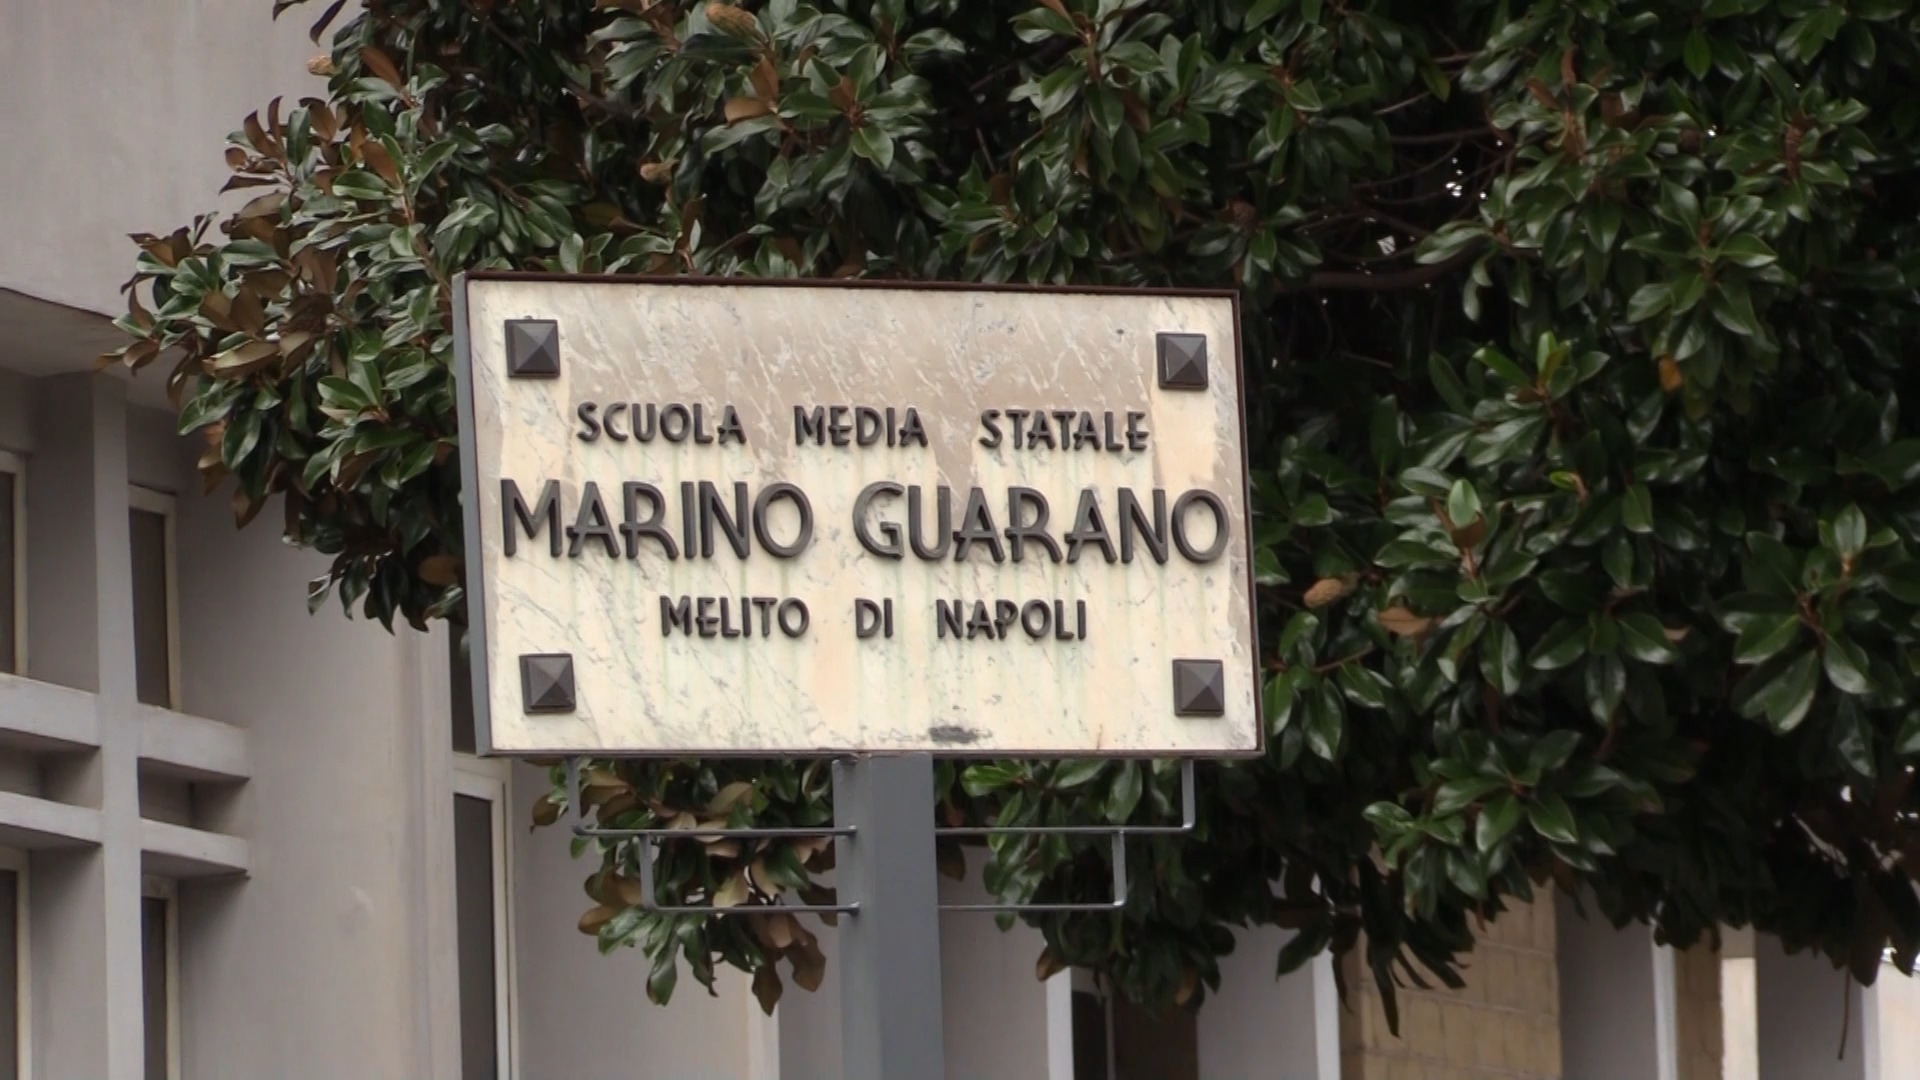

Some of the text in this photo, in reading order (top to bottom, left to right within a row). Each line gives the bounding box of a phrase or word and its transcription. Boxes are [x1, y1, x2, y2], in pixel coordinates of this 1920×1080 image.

[576, 401, 1150, 452] SCUOLA MEDIA STATALE
[500, 477, 1231, 565] MARINO GUARANO
[659, 595, 1087, 641] MELITO DI NAPOLI
